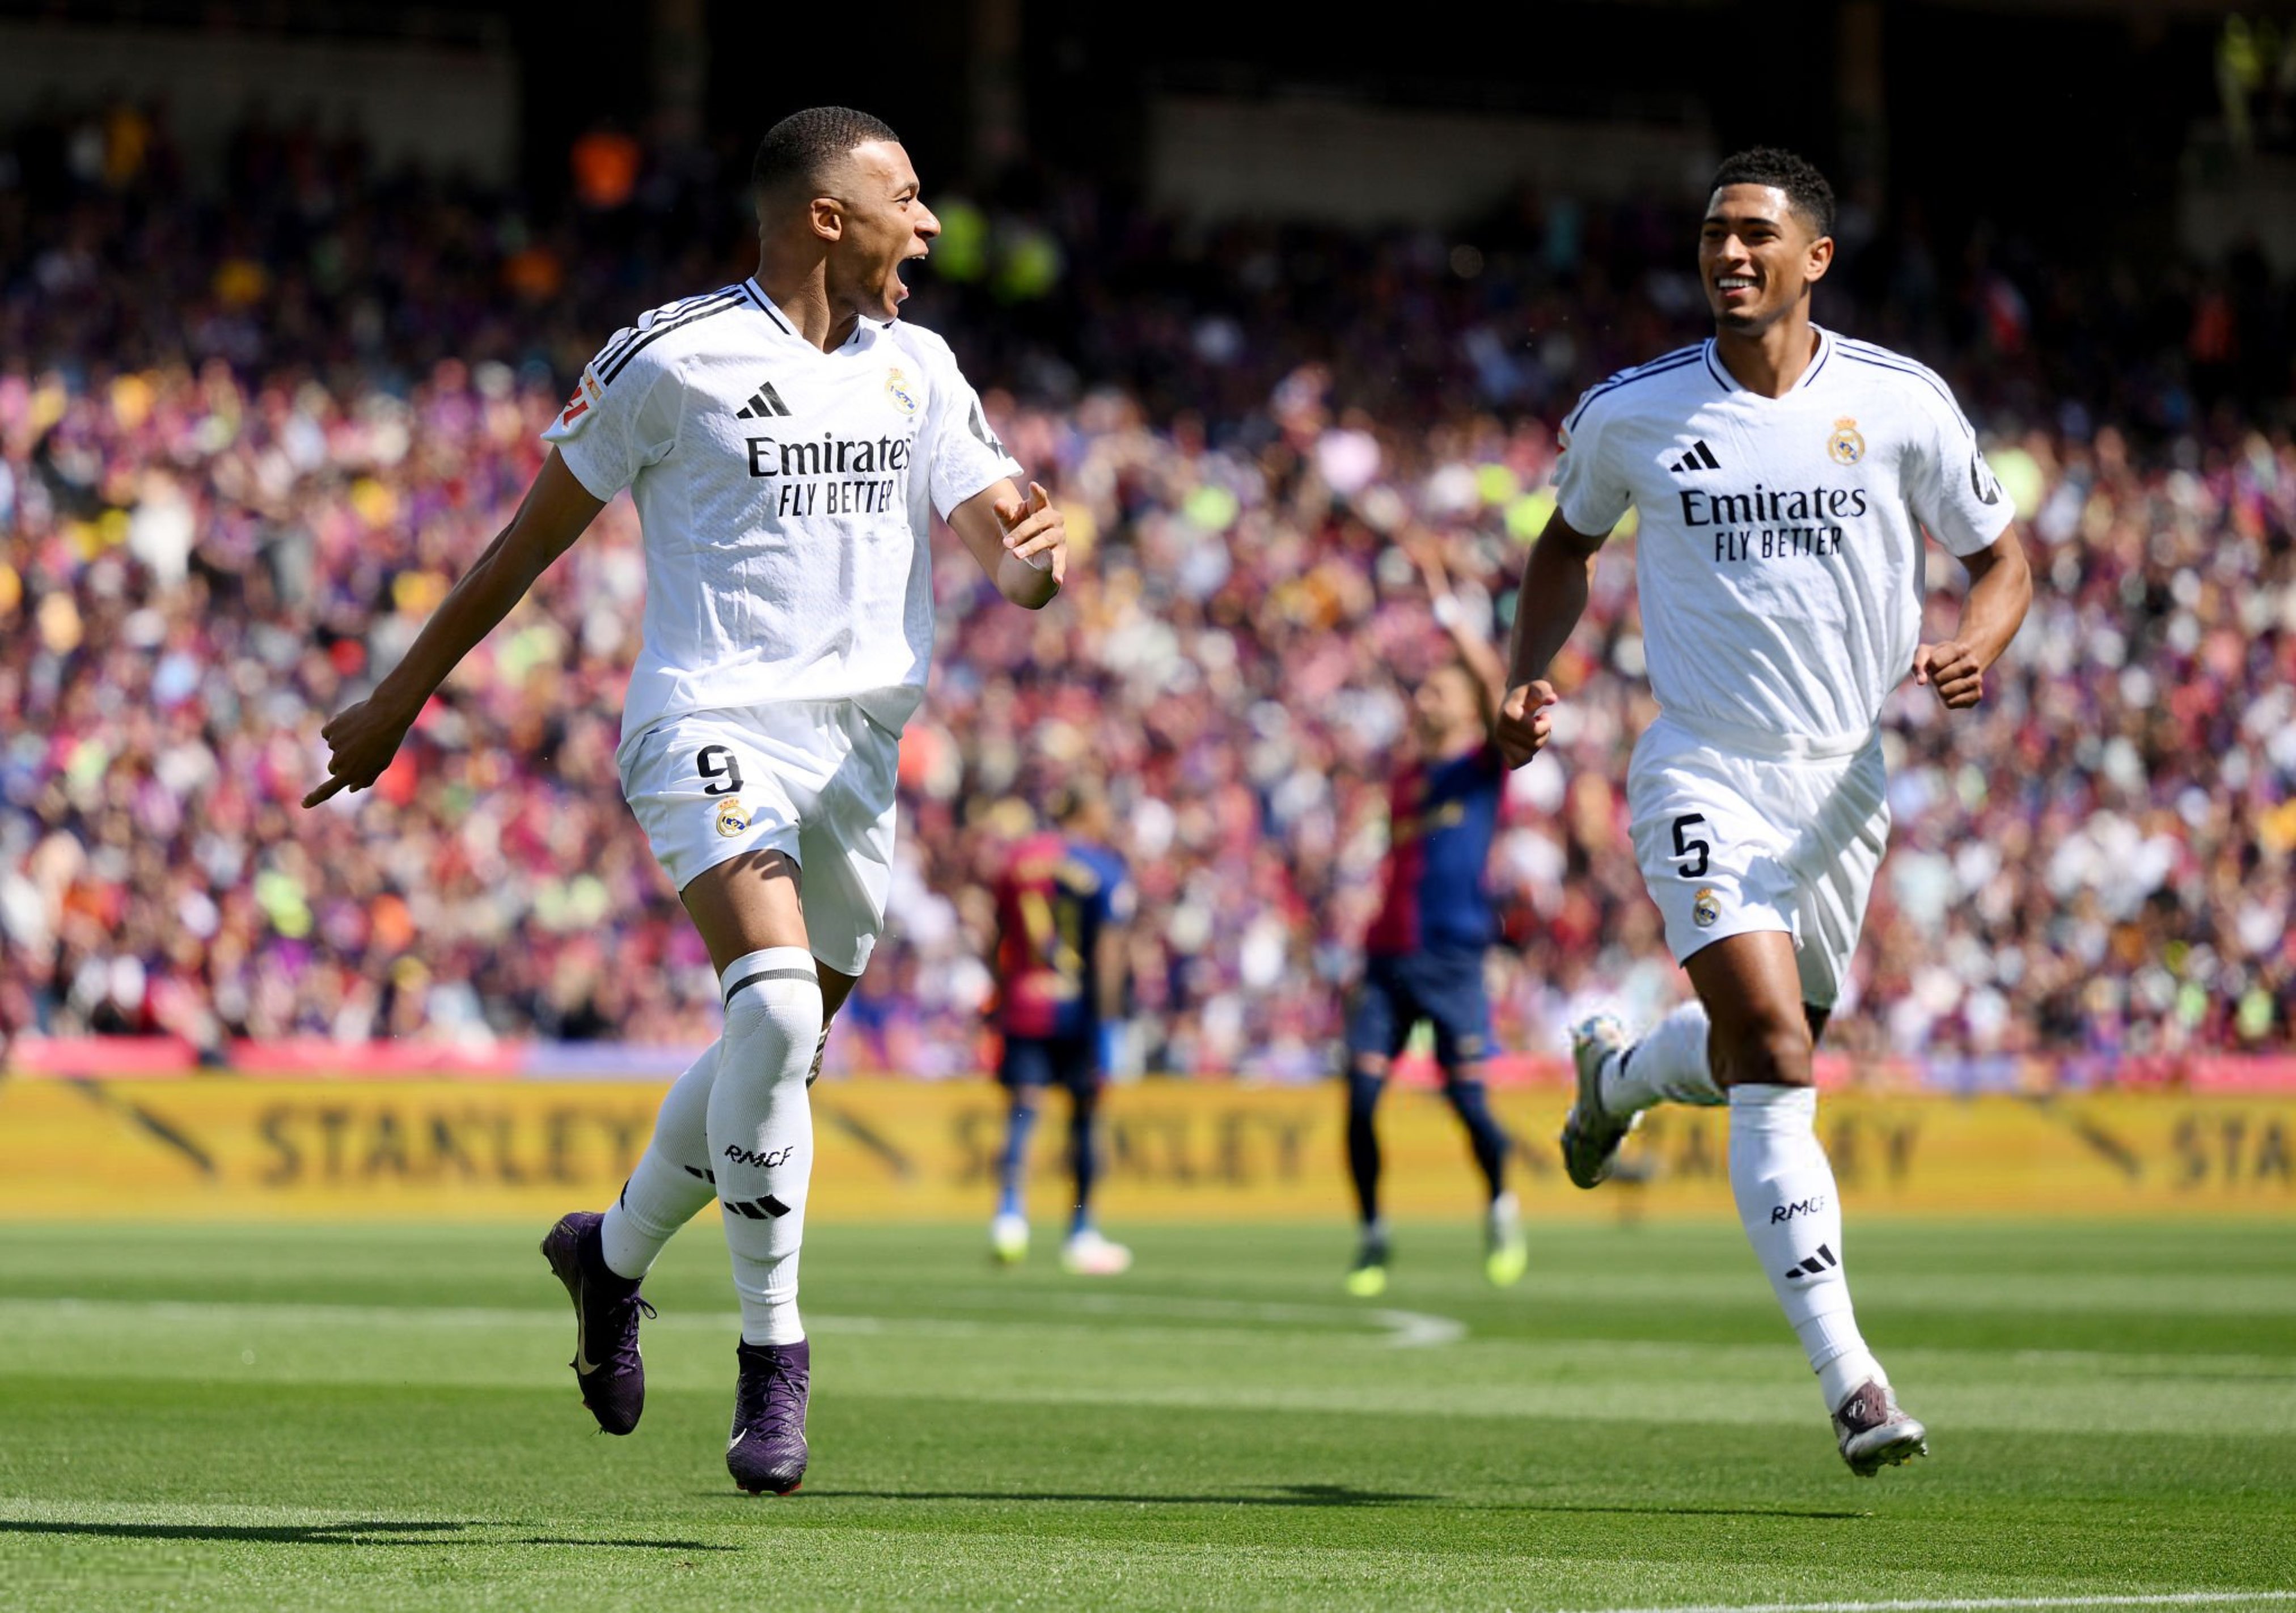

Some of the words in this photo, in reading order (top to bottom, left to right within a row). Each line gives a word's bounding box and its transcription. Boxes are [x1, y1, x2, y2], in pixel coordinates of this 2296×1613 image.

[778, 482, 817, 517] FLY
[827, 479, 894, 515] BETTER
[1679, 484, 1866, 527] Emirates
[1715, 531, 1749, 562] FLY
[1761, 526, 1842, 559] BETTER
[697, 744, 744, 795] 9
[1672, 813, 1710, 878] 5
[256, 1101, 652, 1187] STANLEY
[725, 1144, 793, 1167] RMCF
[1771, 1196, 1824, 1225] RMCF
